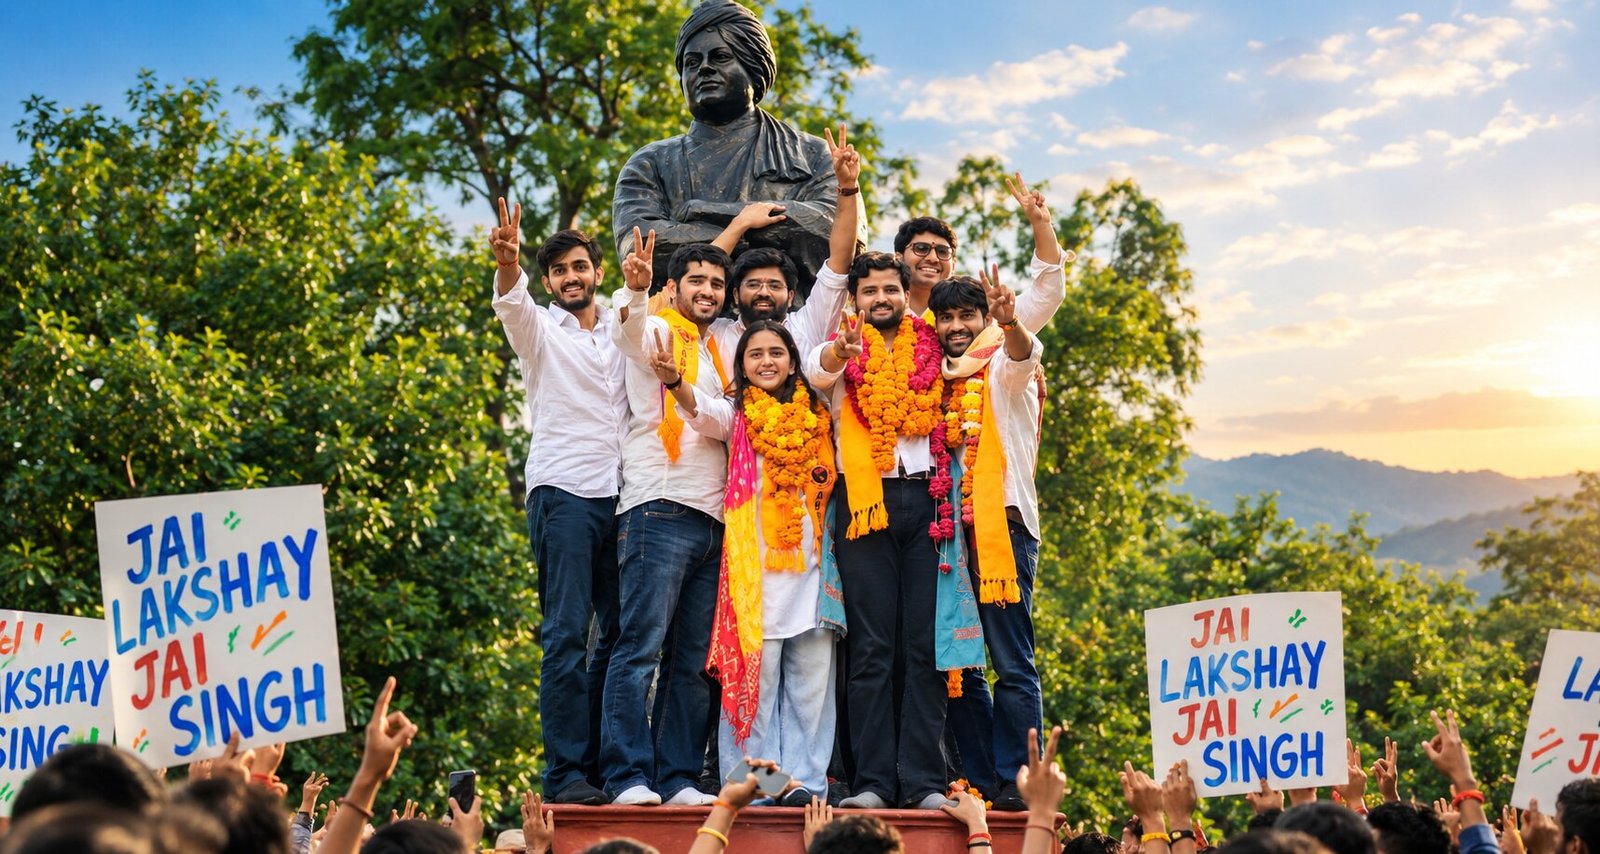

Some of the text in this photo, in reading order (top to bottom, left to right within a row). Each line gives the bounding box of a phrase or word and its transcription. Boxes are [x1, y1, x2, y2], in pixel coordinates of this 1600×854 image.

[126, 511, 207, 585] JAI
[112, 528, 318, 655] LAKSHAY
[1190, 607, 1250, 649] JAI
[0, 658, 109, 714] KSHAY
[130, 632, 208, 711] JAI
[1159, 640, 1327, 704] LAKSHAY
[169, 662, 327, 757] SINGH
[1172, 698, 1237, 746] JAI
[1202, 731, 1324, 788] SINGH
